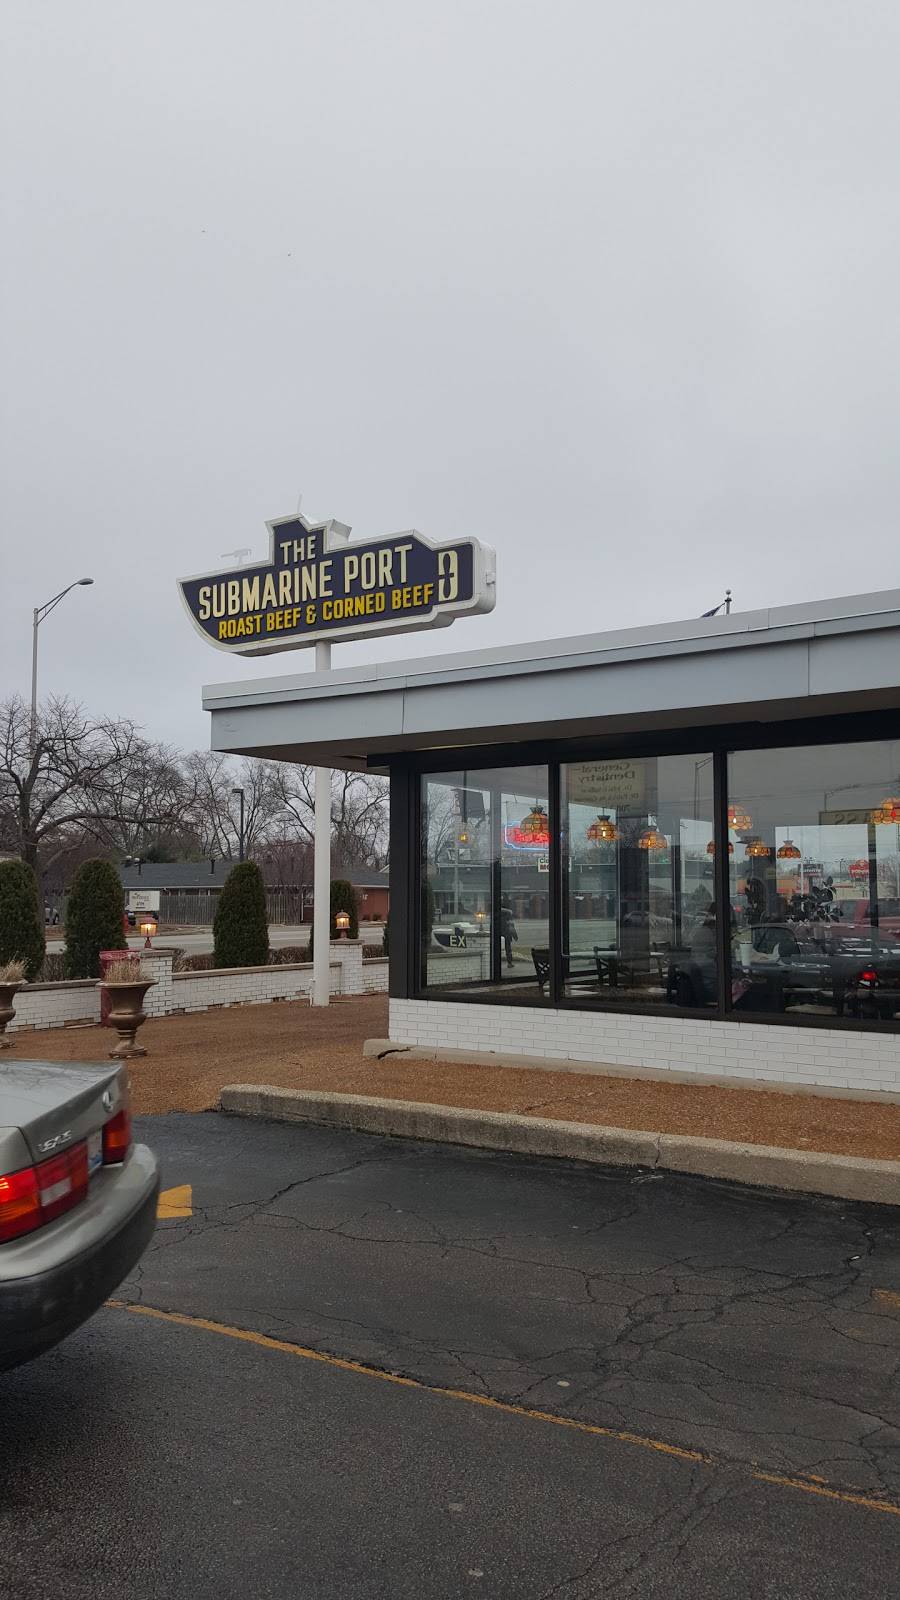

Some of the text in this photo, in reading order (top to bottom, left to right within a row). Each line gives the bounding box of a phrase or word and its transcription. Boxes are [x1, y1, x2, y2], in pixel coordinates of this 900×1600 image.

[280, 535, 316, 565] THE
[198, 560, 333, 620] SUBMARINE
[344, 543, 413, 593] PORT
[218, 583, 433, 640] ROAST BEEF & CORNED BEEF
